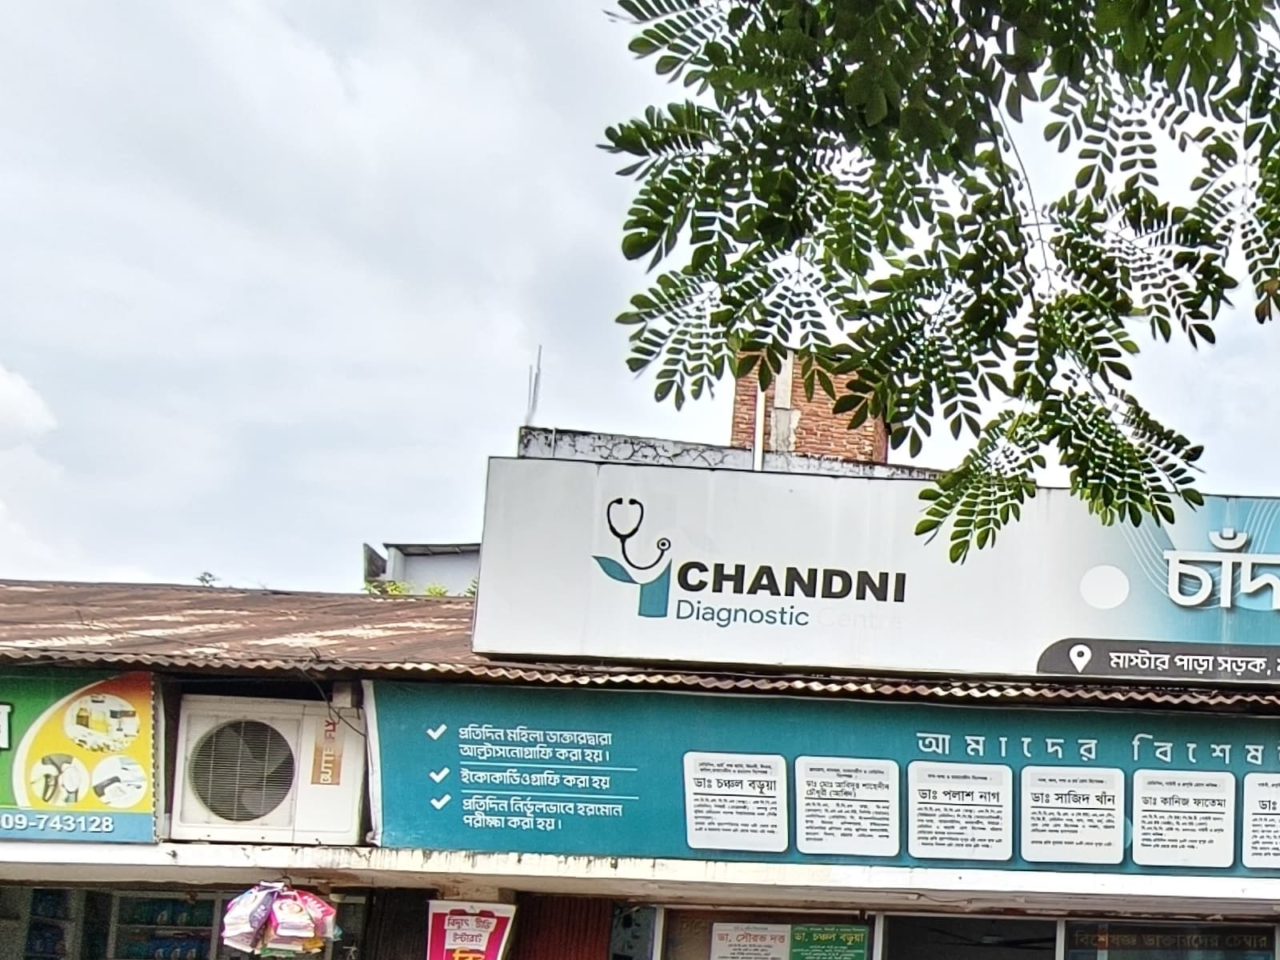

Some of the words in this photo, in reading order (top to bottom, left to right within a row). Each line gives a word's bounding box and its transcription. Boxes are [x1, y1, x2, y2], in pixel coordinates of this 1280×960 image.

[677, 561, 906, 603] CHANDNI
[676, 600, 810, 627] Diagnostic
[1109, 651, 1169, 671] মাস্টার
[1174, 654, 1214, 674] পাড়া
[1217, 655, 1271, 676] সড়ক,
[458, 724, 504, 740] প্রতিদিন
[506, 726, 544, 742] মহিলা
[319, 719, 337, 785] BUTTEFLY
[556, 748, 582, 761] করা
[917, 733, 1098, 760] আমাদের
[563, 775, 589, 788] করা
[591, 776, 610, 789] হয়
[462, 795, 508, 811] প্রতিদিন
[576, 803, 623, 817] হরমোন
[942, 789, 974, 802] পলাশ
[979, 791, 1000, 804] নাগ
[1054, 790, 1090, 804] সাজিদ
[463, 811, 504, 828] পরীক্ষা
[507, 816, 534, 829] করা
